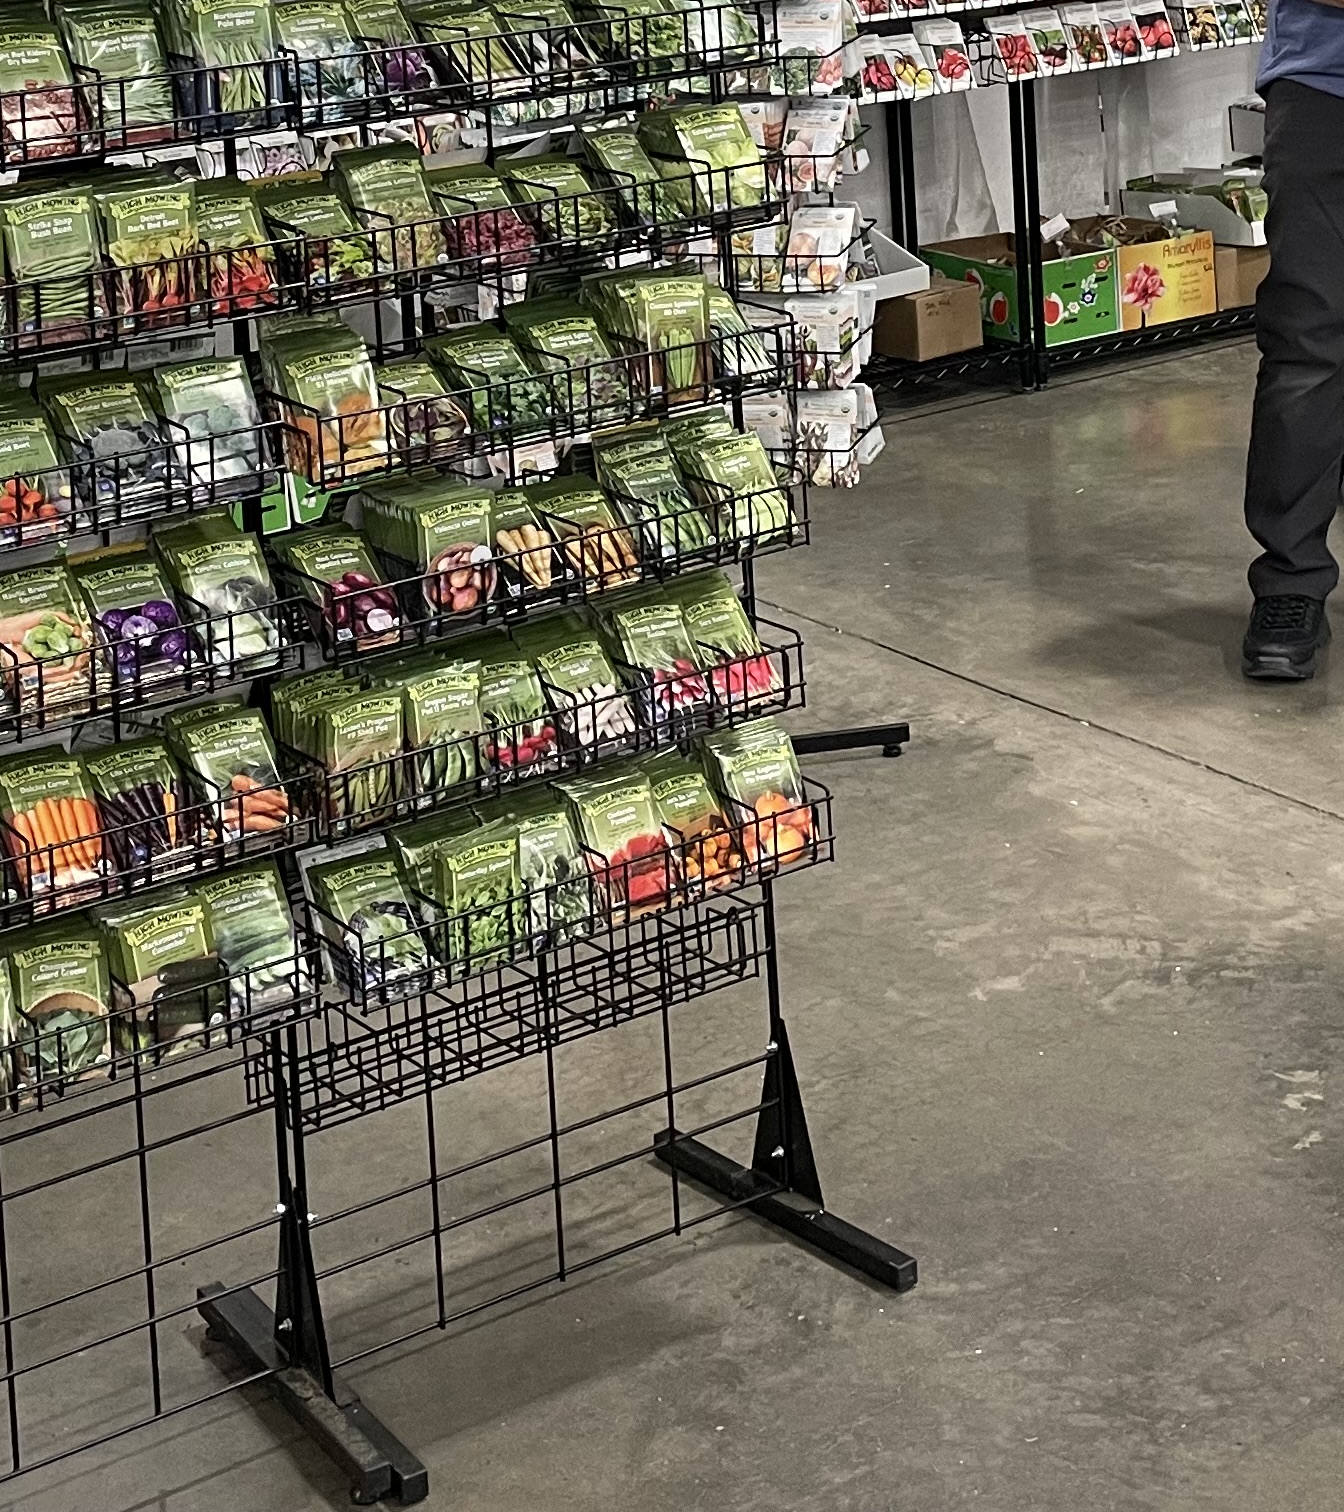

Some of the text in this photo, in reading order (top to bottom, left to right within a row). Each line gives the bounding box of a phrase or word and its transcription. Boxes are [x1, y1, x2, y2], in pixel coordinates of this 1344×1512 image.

[16, 198, 80, 216] HIGH MOWING
[120, 194, 182, 212] HIGH MOWING
